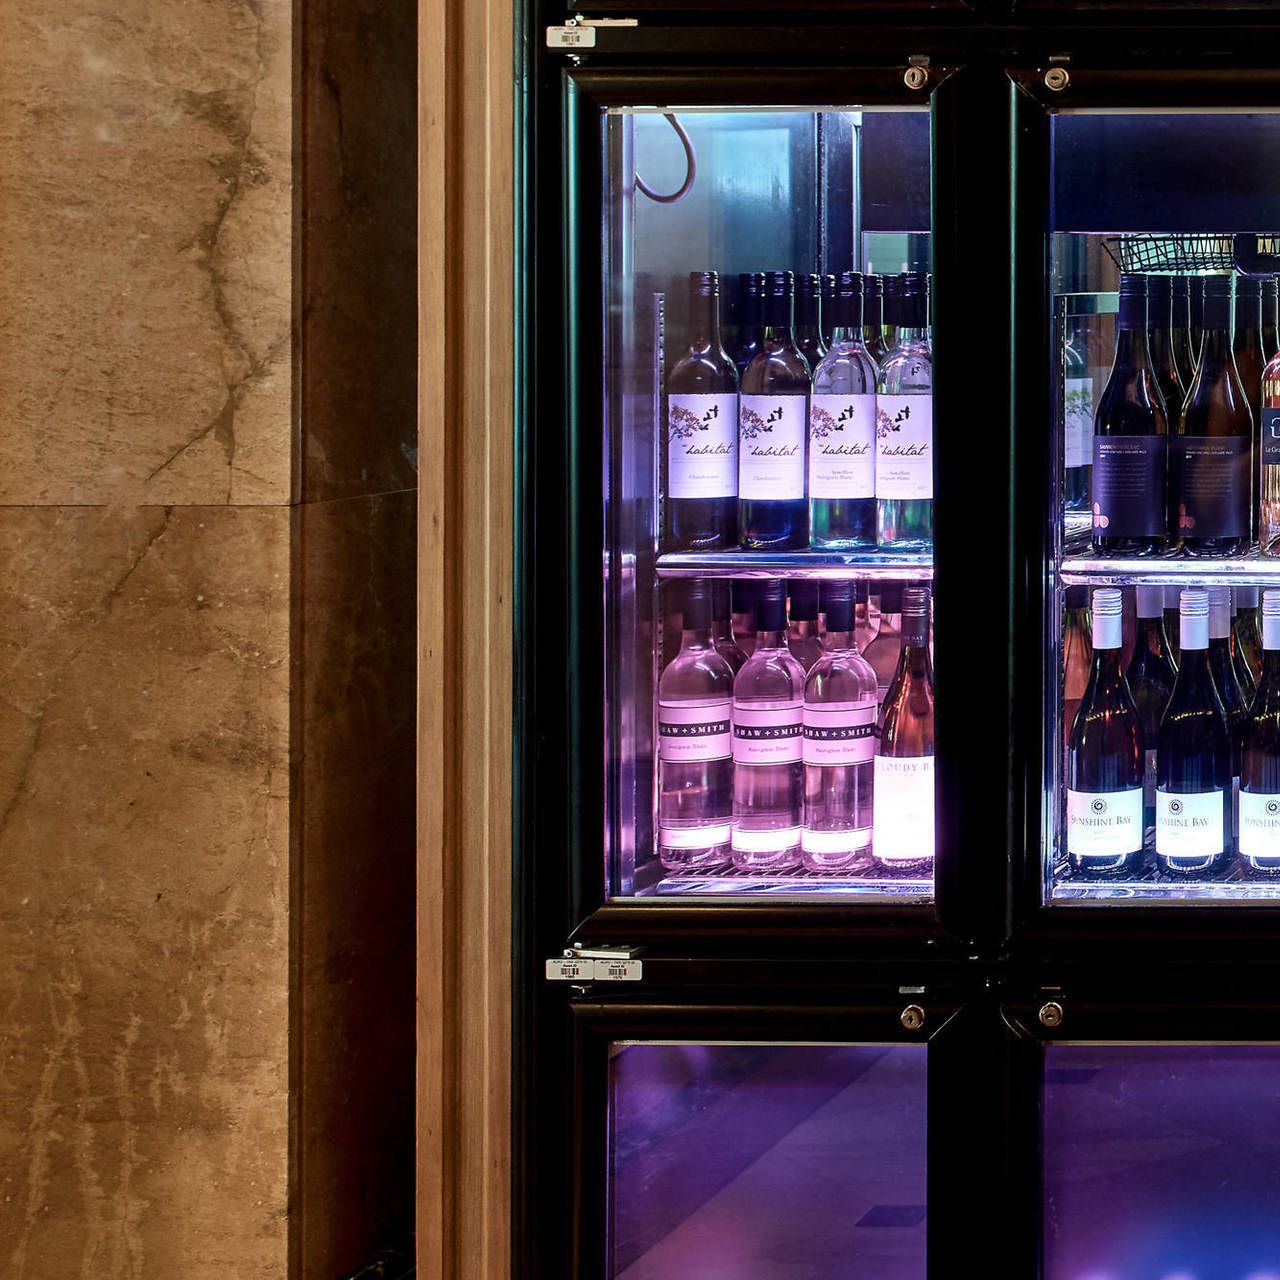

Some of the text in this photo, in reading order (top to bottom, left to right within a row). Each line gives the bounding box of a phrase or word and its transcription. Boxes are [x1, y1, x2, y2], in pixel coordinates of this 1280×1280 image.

[686, 441, 735, 456] habitat
[750, 443, 801, 457] habitat
[822, 441, 872, 456] habitat
[882, 441, 930, 457] habitat
[690, 723, 725, 734] SMITH
[805, 729, 829, 738] SHAW
[841, 727, 872, 737] SMITH
[1071, 815, 1132, 826] SUNSHINE BAY
[1192, 817, 1209, 827] BAY
